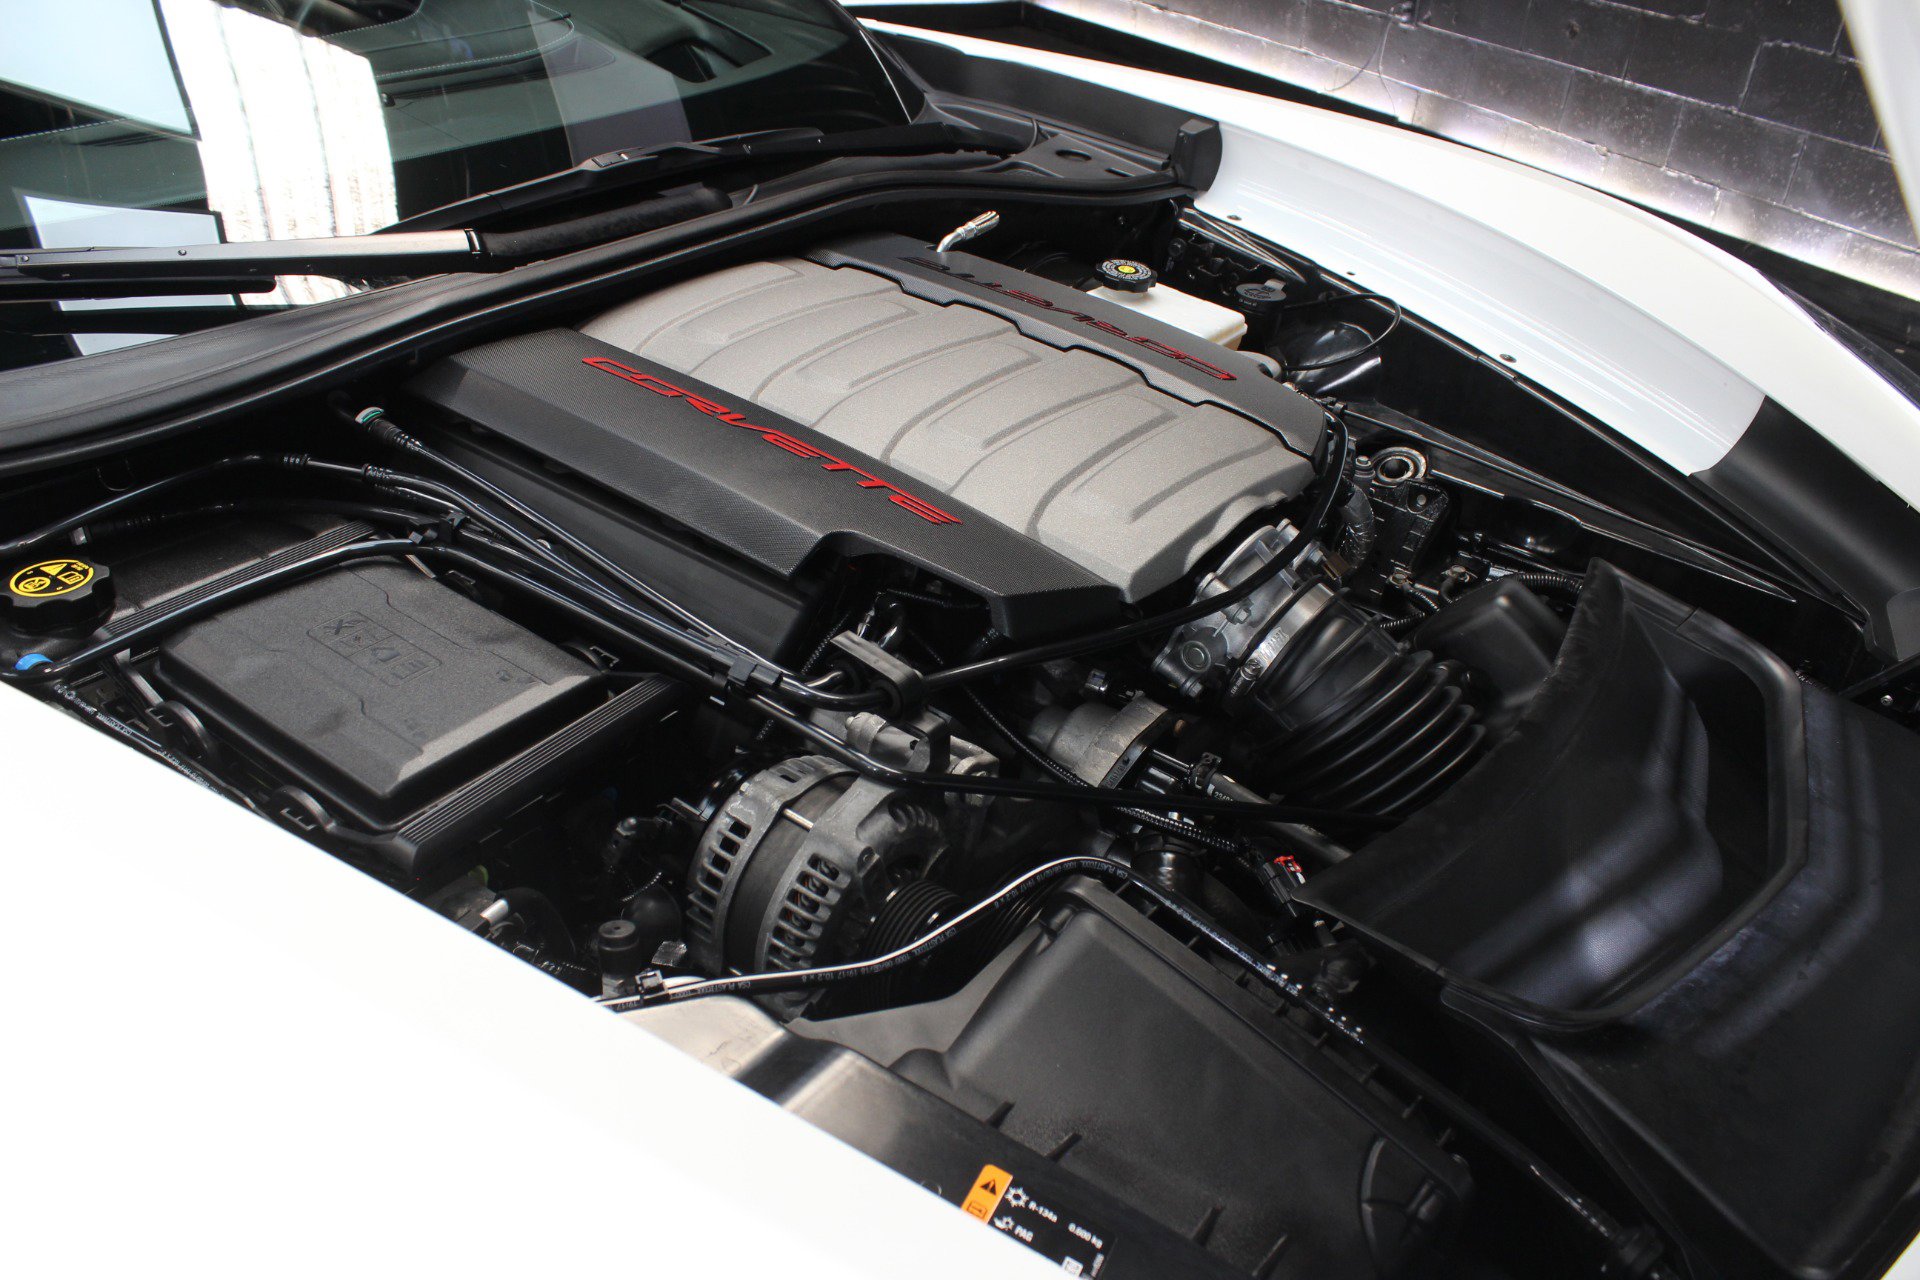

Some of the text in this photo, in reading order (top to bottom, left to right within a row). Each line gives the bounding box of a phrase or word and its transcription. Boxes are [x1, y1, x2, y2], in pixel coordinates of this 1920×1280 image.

[897, 256, 1238, 381] CORVETTE
[582, 356, 963, 525] CORVETTE
[1014, 1225, 1034, 1242] PAG
